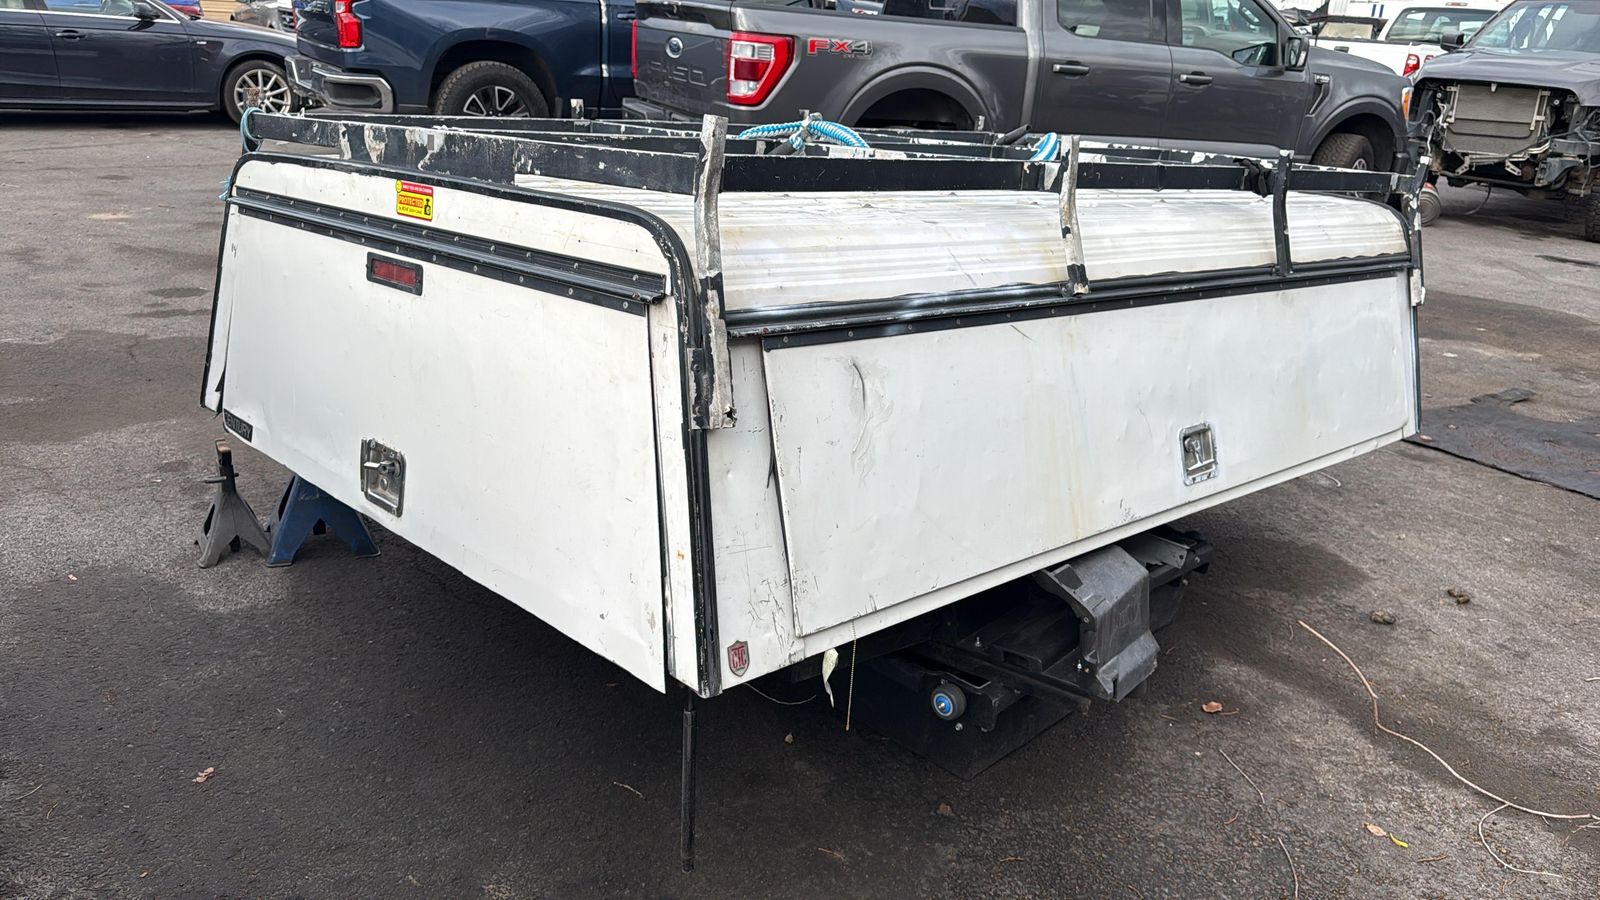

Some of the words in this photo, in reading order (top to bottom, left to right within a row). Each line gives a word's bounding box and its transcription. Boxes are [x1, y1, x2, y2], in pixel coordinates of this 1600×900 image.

[808, 37, 873, 55] FX4
[398, 195, 424, 208] PROTECTED
[731, 645, 747, 669] CTC
